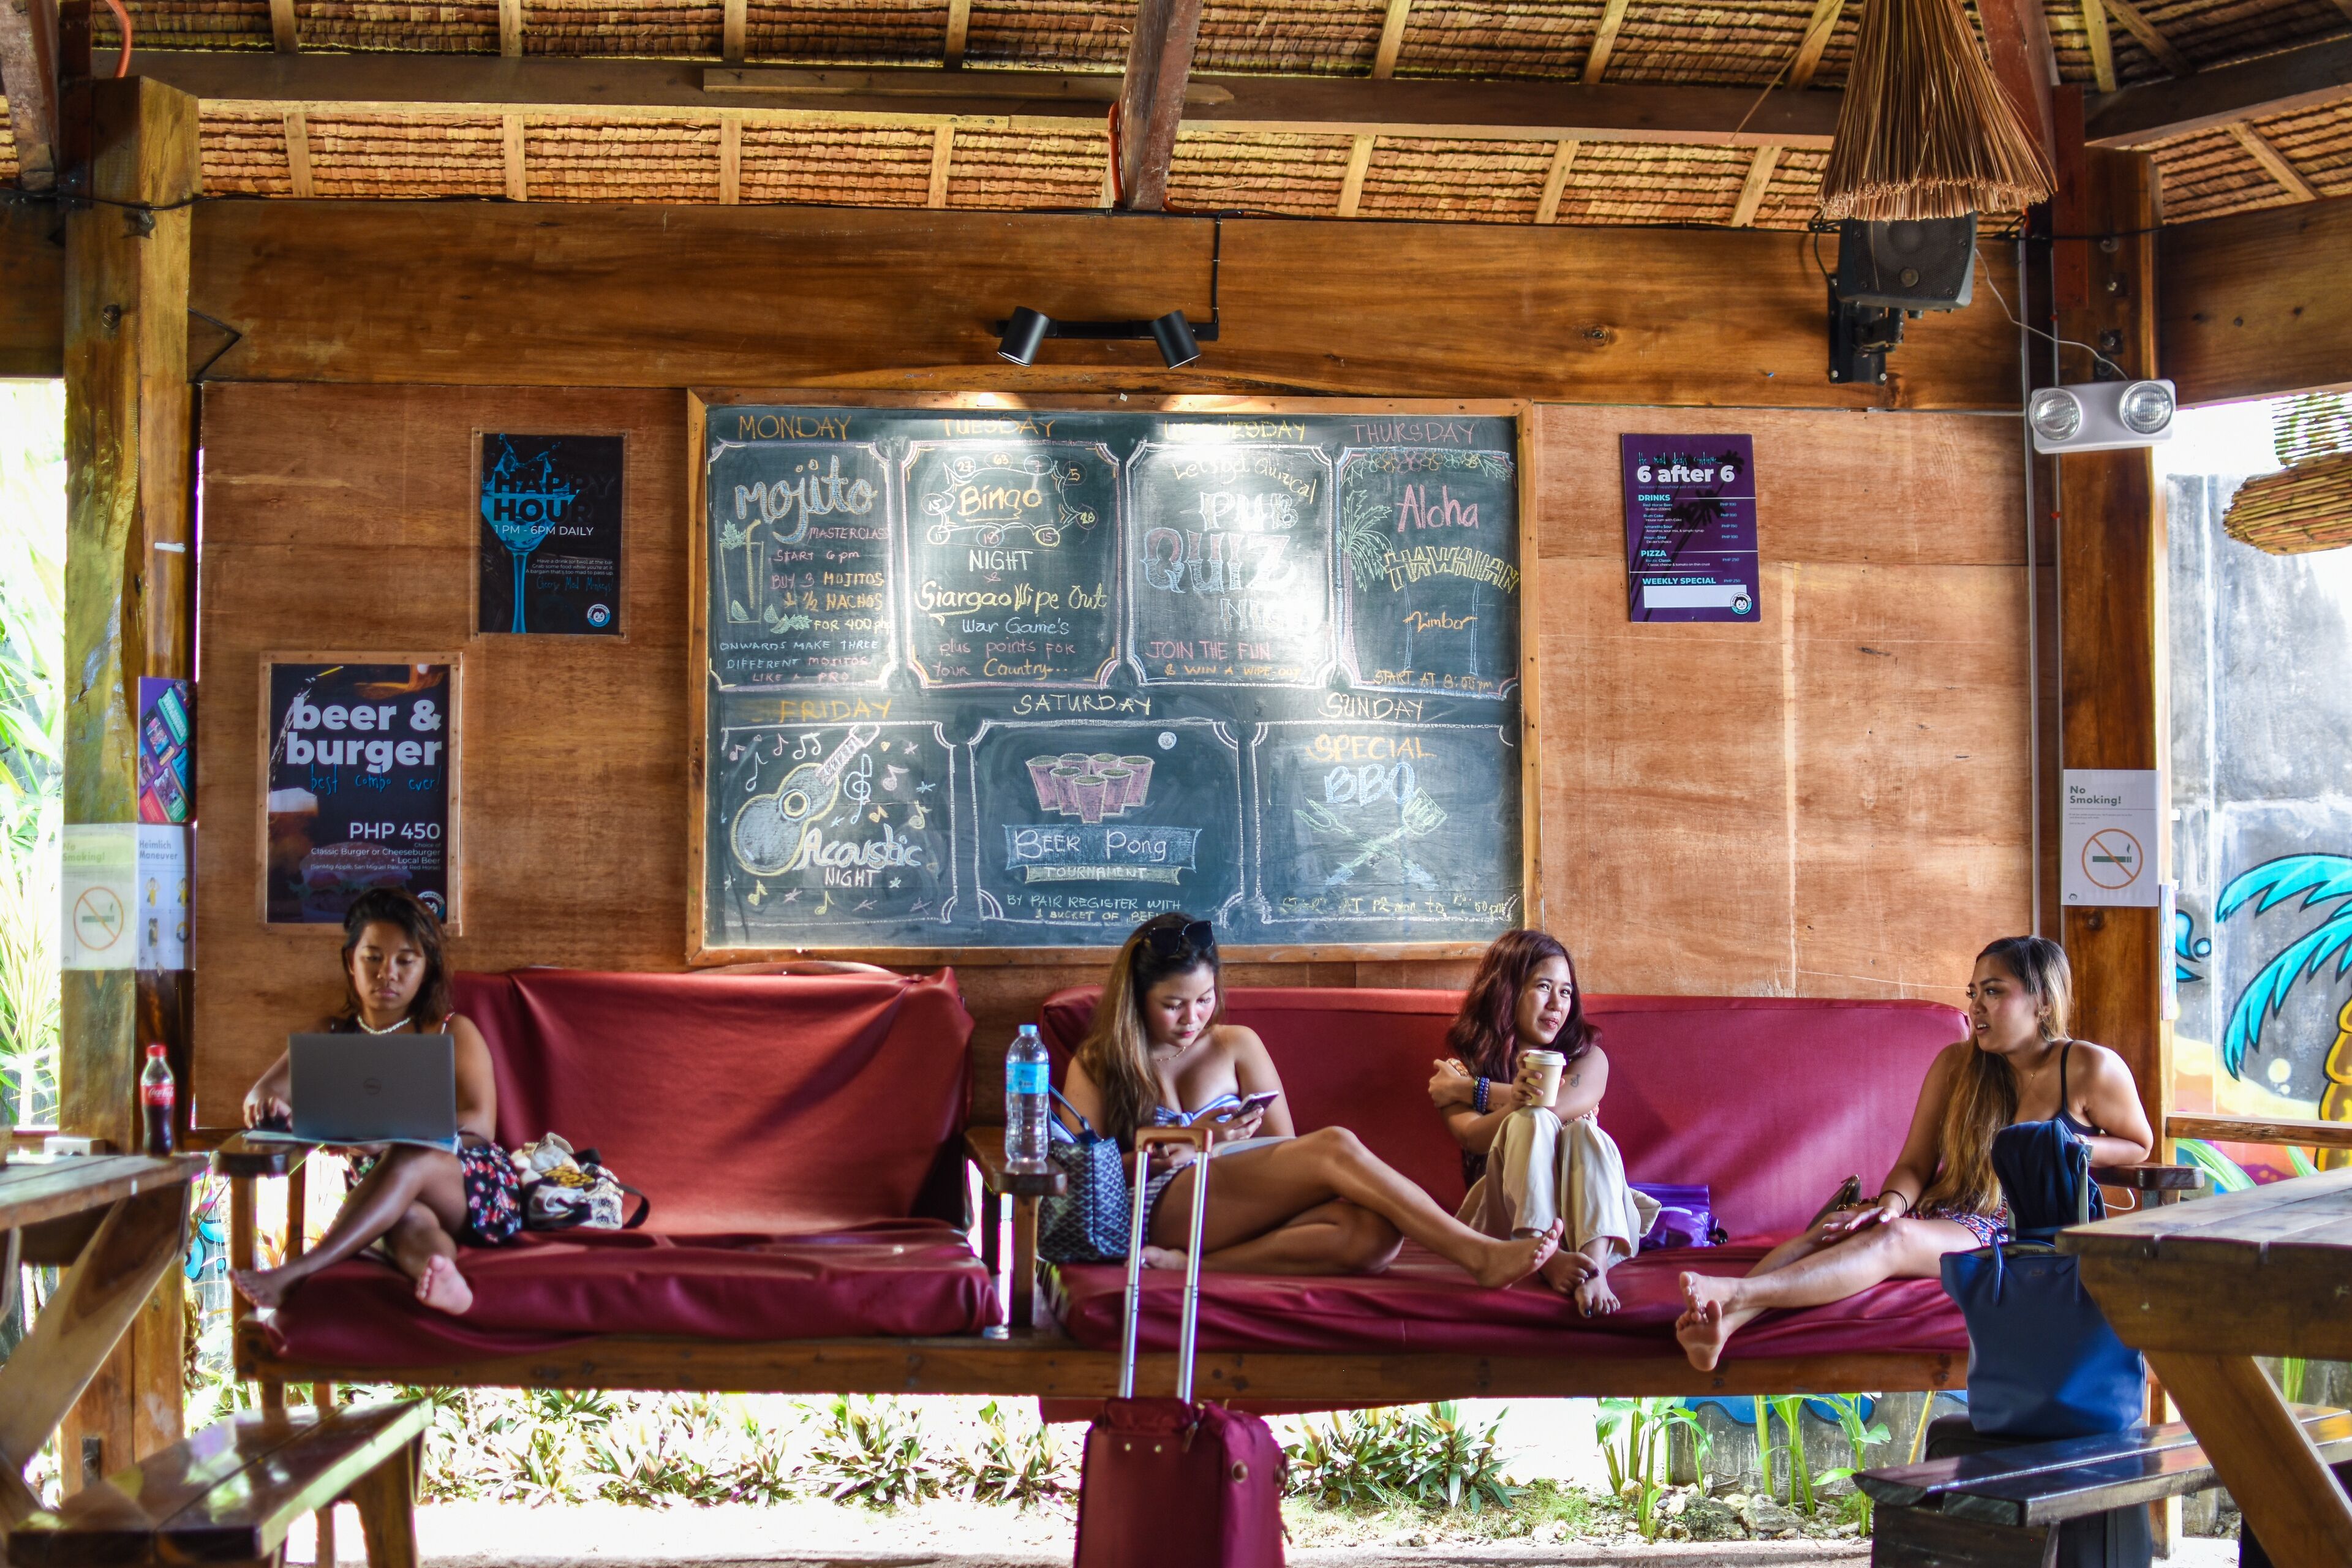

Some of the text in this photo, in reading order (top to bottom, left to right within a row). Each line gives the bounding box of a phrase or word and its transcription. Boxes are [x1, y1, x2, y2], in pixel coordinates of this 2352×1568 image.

[739, 415, 851, 440] MONDAY
[938, 416, 1056, 437] TUESDAY
[1351, 422, 1475, 445] THURSDAY
[957, 460, 974, 472] 27
[1030, 459, 1042, 472] 7
[1638, 452, 1648, 465] the
[1672, 452, 1687, 466] deals
[494, 470, 615, 496] HAPPY
[1068, 469, 1081, 481] 5
[1637, 465, 1735, 483] 6 after 6
[735, 455, 878, 544] mojito
[957, 484, 1042, 518] Bingo
[1395, 484, 1480, 533] Aloha
[494, 498, 594, 523] HOUR
[1198, 491, 1299, 532] PUB
[502, 525, 520, 534] PM
[530, 525, 556, 535] 6PM
[559, 526, 594, 537] DAILY
[807, 527, 889, 544] MASTERCLASS
[982, 531, 1000, 545] 18
[1042, 532, 1052, 542] 15
[774, 551, 813, 562] START
[969, 549, 1033, 572] NIGHT
[1139, 527, 1297, 594] QUIZ
[1384, 546, 1520, 594] HAWAIIAN
[771, 571, 884, 589] BUY 3 MOJITOS
[826, 592, 883, 611] NACHOS
[914, 581, 1108, 617] Siargao Wipe Out
[813, 620, 840, 631] FOR
[844, 618, 872, 630] 400
[962, 617, 1070, 635] War Game's
[720, 639, 878, 651] ONWARDS MAKE THREE
[939, 638, 971, 657] plus
[985, 637, 1036, 659] points
[1145, 641, 1272, 660] JOIN THE FUN
[726, 656, 870, 669] DIFFERENT MOJITOS
[1183, 665, 1216, 675] WIN
[1224, 666, 1234, 676] A
[752, 673, 783, 682] LIKE
[817, 672, 850, 683] PRO
[1373, 669, 1415, 685] START
[1420, 672, 1436, 687] AT
[1477, 680, 1494, 696] pm
[293, 696, 442, 732] beer &
[779, 698, 892, 723] FRIDAY
[1013, 694, 1152, 716] SATURDAY
[1317, 692, 1424, 722] SUNDAY
[287, 732, 442, 774] burger
[1305, 734, 1437, 763] SPECIAL
[309, 763, 442, 794] best combo ever!
[1324, 761, 1417, 807] BBQ
[2070, 785, 2086, 794] No
[2070, 795, 2122, 807] Smoking!
[350, 822, 441, 840] PHP 450
[62, 842, 77, 852] No
[139, 840, 172, 850] Heimlich
[341, 848, 369, 858] Burger
[382, 848, 440, 858] Cheeseburger
[793, 823, 922, 870] Acoustic
[1106, 829, 1167, 862] Pong
[62, 852, 105, 864] Smoking!
[139, 850, 178, 861] Maneuver
[824, 867, 883, 888] NIGHT
[1043, 866, 1148, 881] TOURNAMENT
[1006, 894, 1182, 911] BY PAIR REGISTER WITH
[1035, 908, 1044, 919] 1
[1049, 910, 1096, 921] BUCKET
[1101, 912, 1119, 921] OF
